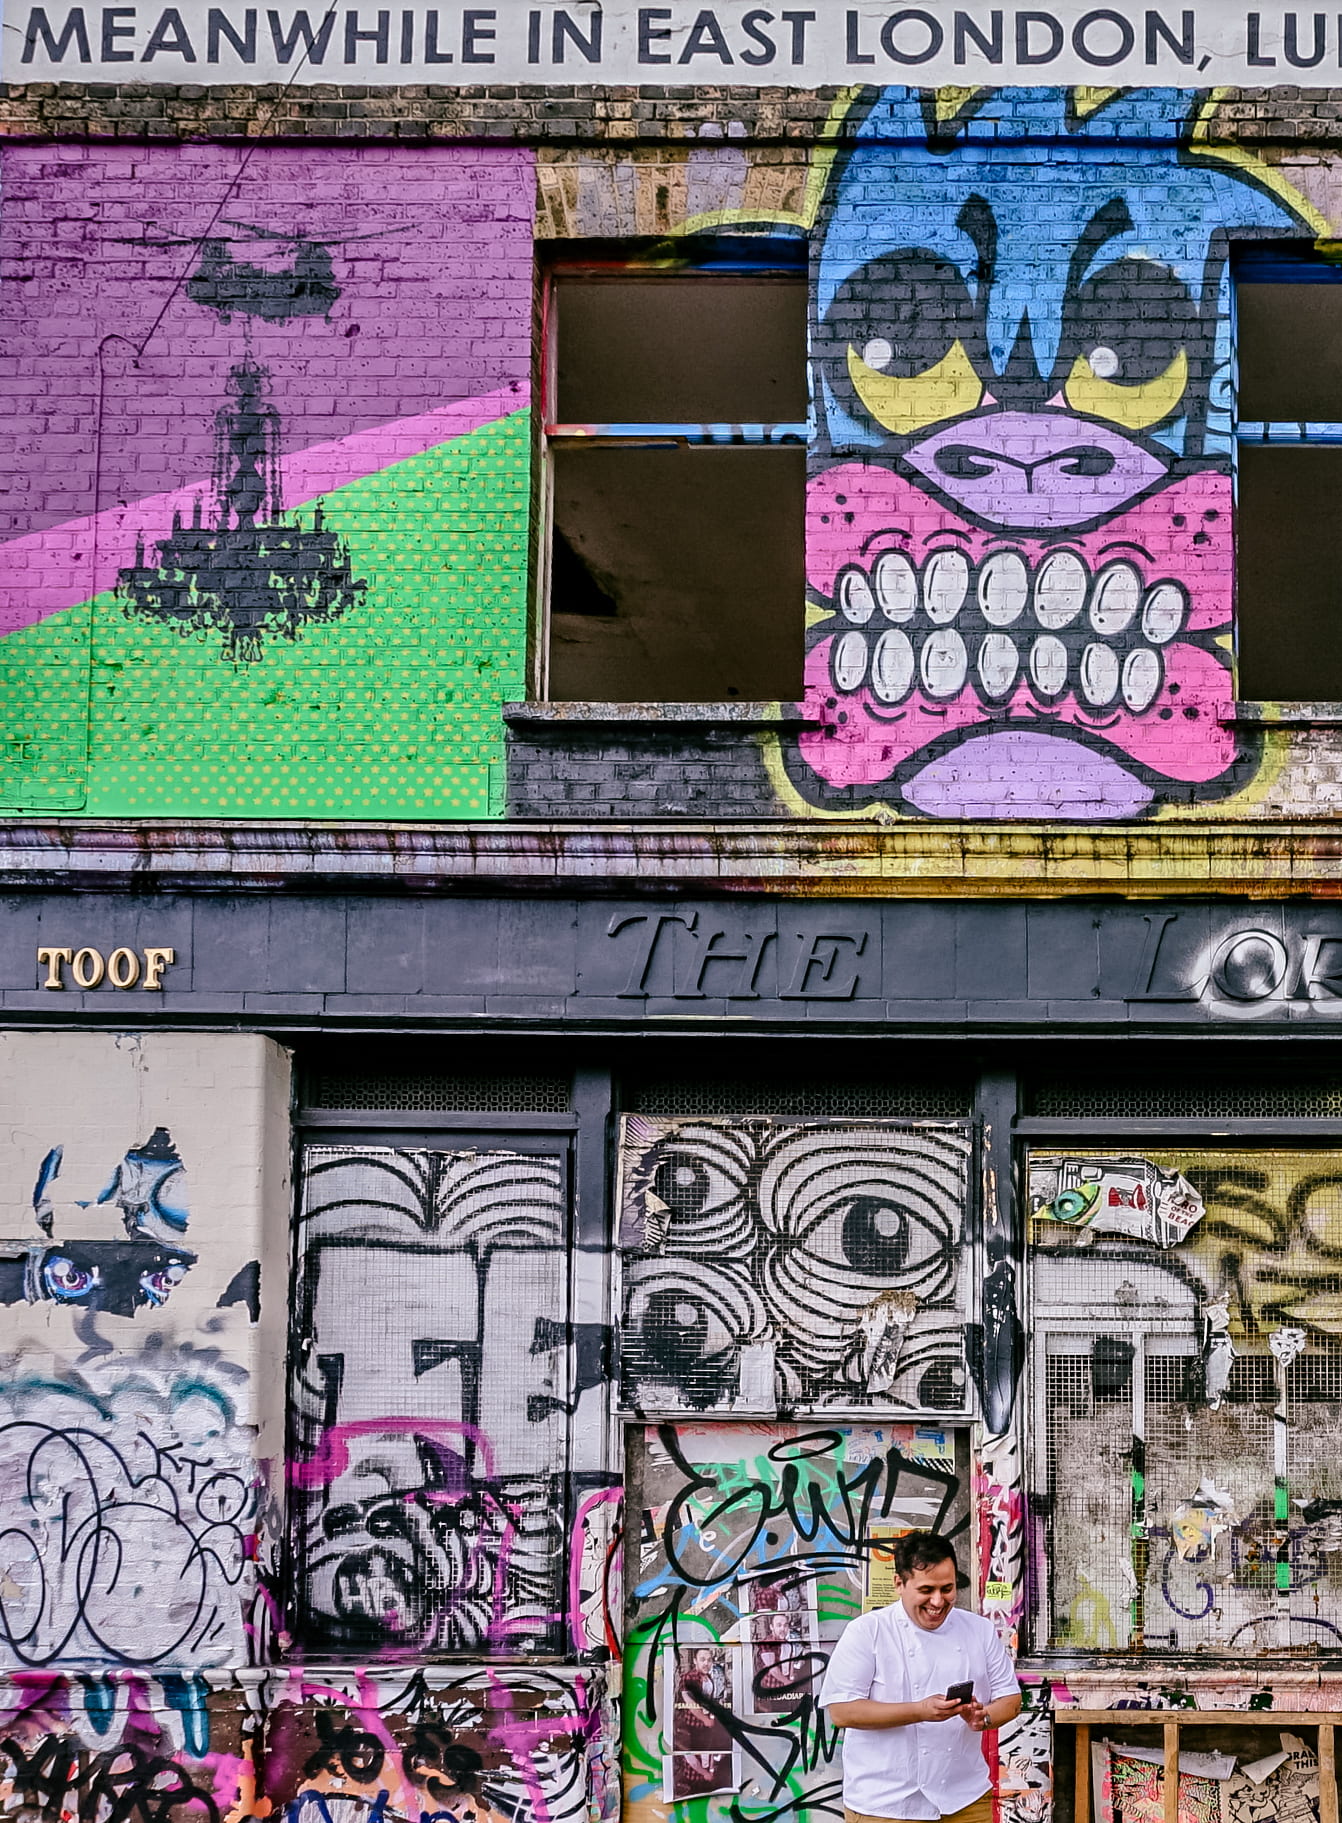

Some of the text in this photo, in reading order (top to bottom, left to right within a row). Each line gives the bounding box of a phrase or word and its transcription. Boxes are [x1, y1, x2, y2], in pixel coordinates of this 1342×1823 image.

[20, 8, 497, 64] MEANWHILE
[527, 8, 603, 64] IN
[637, 9, 816, 65] EAST
[847, 10, 1211, 71] LONDON,
[36, 947, 174, 991] TOOF
[608, 911, 869, 1000] THE
[1294, 1759, 1319, 1770] THIS
